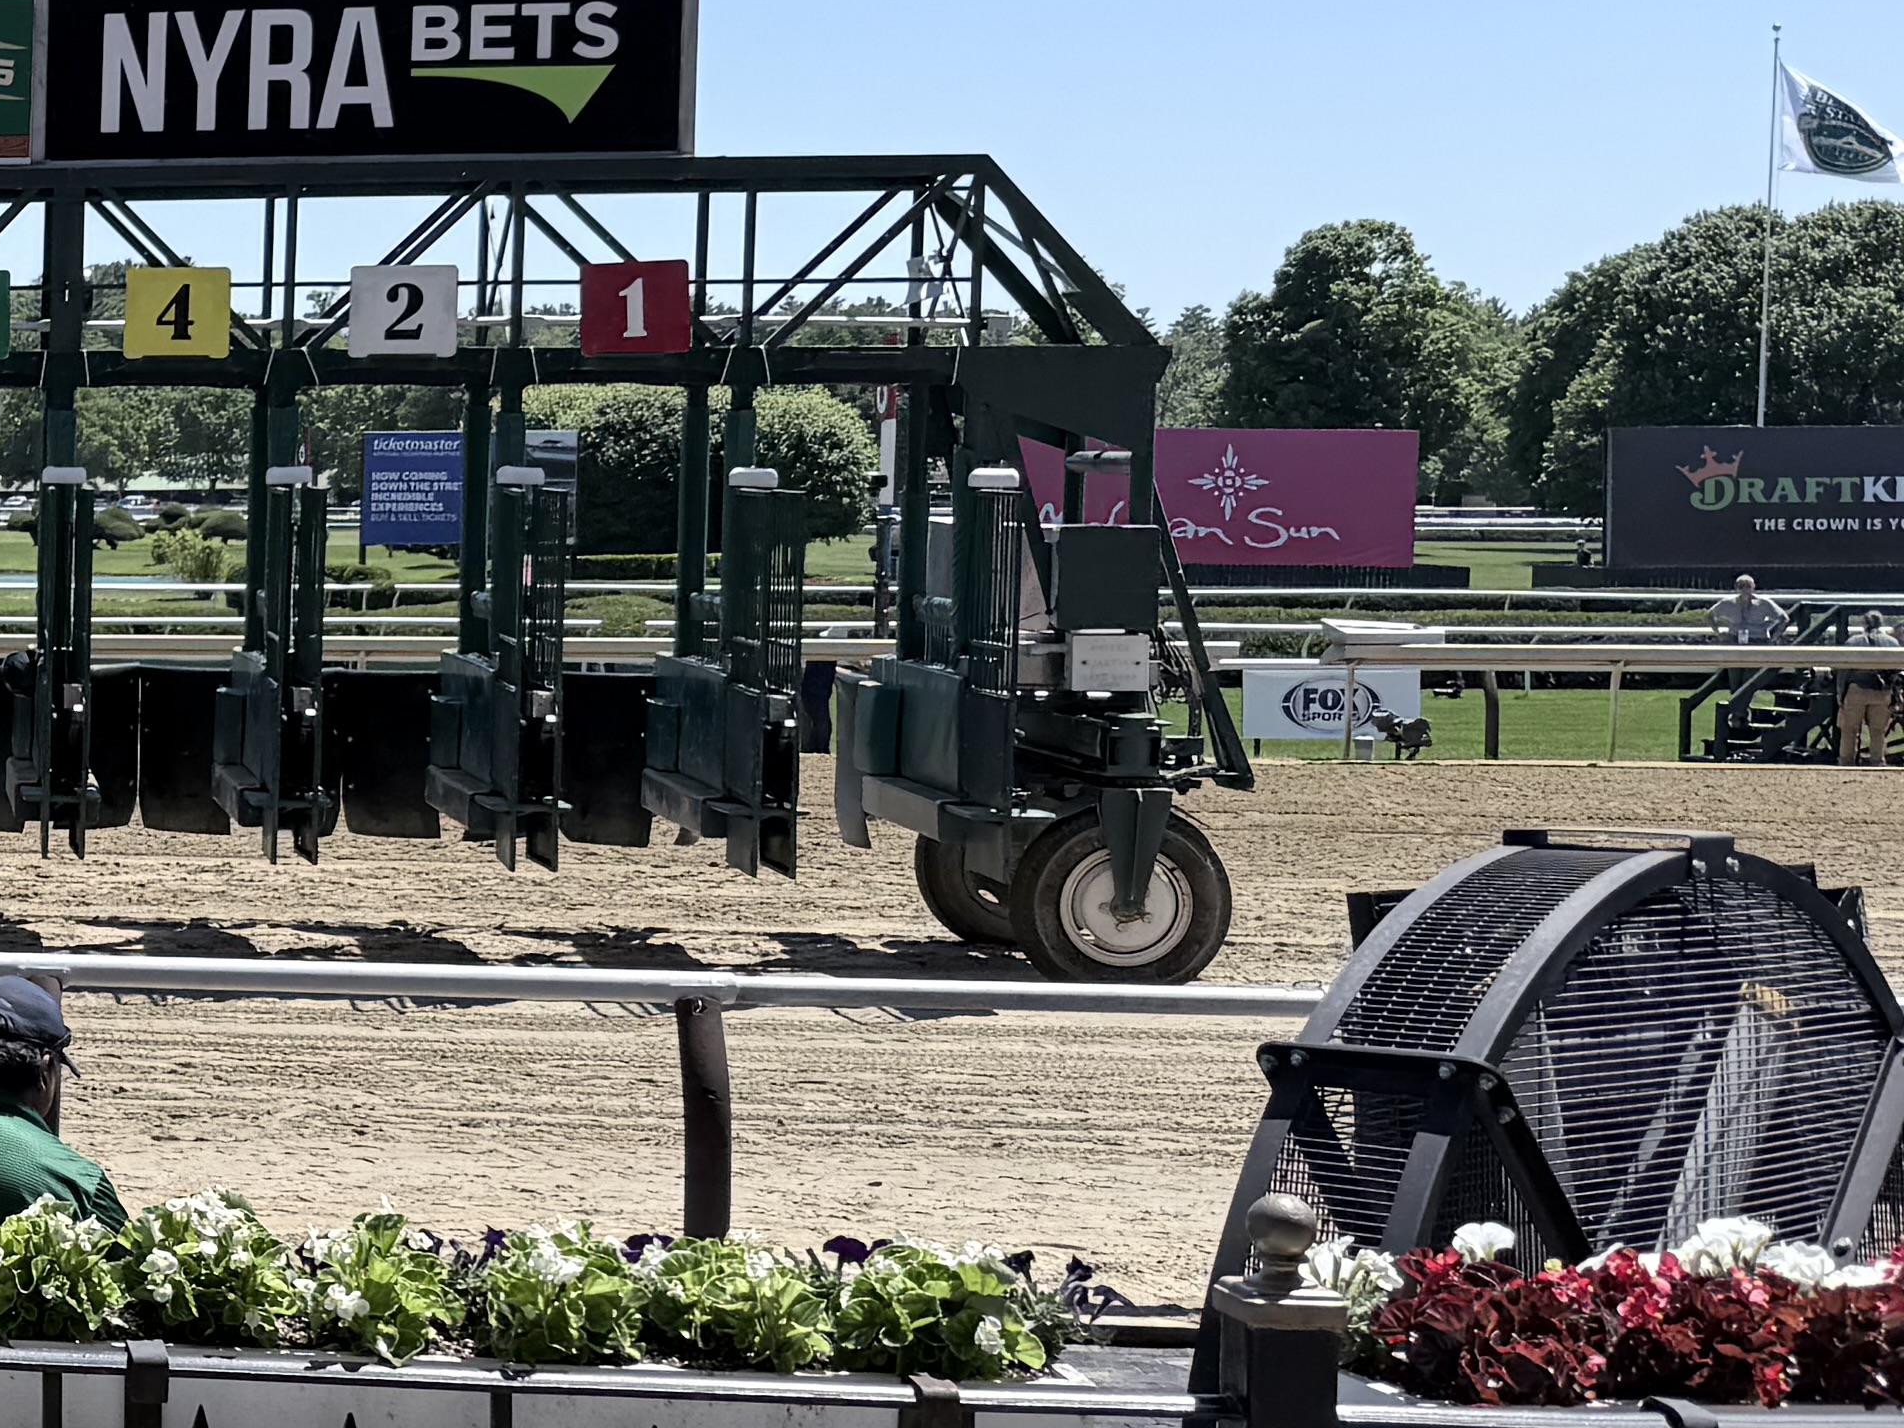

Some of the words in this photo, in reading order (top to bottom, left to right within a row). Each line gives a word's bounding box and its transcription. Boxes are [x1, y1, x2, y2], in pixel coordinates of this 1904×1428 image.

[100, 7, 394, 133] NYRA
[411, 1, 620, 62] BETS
[155, 282, 195, 341] 4
[384, 282, 424, 341] 2
[617, 276, 649, 339] 1
[373, 437, 461, 451] ticketmaster
[371, 481, 407, 491] DOWN
[409, 481, 431, 491] THE
[372, 471, 400, 481] NOW
[402, 471, 448, 481] COMING
[1244, 507, 1341, 548] Sun
[1754, 517, 1787, 531] THE
[1792, 517, 1860, 531] CROWN
[1866, 517, 1883, 531] IS
[1302, 687, 1360, 712] FOX
[1302, 712, 1361, 722] SPORS
